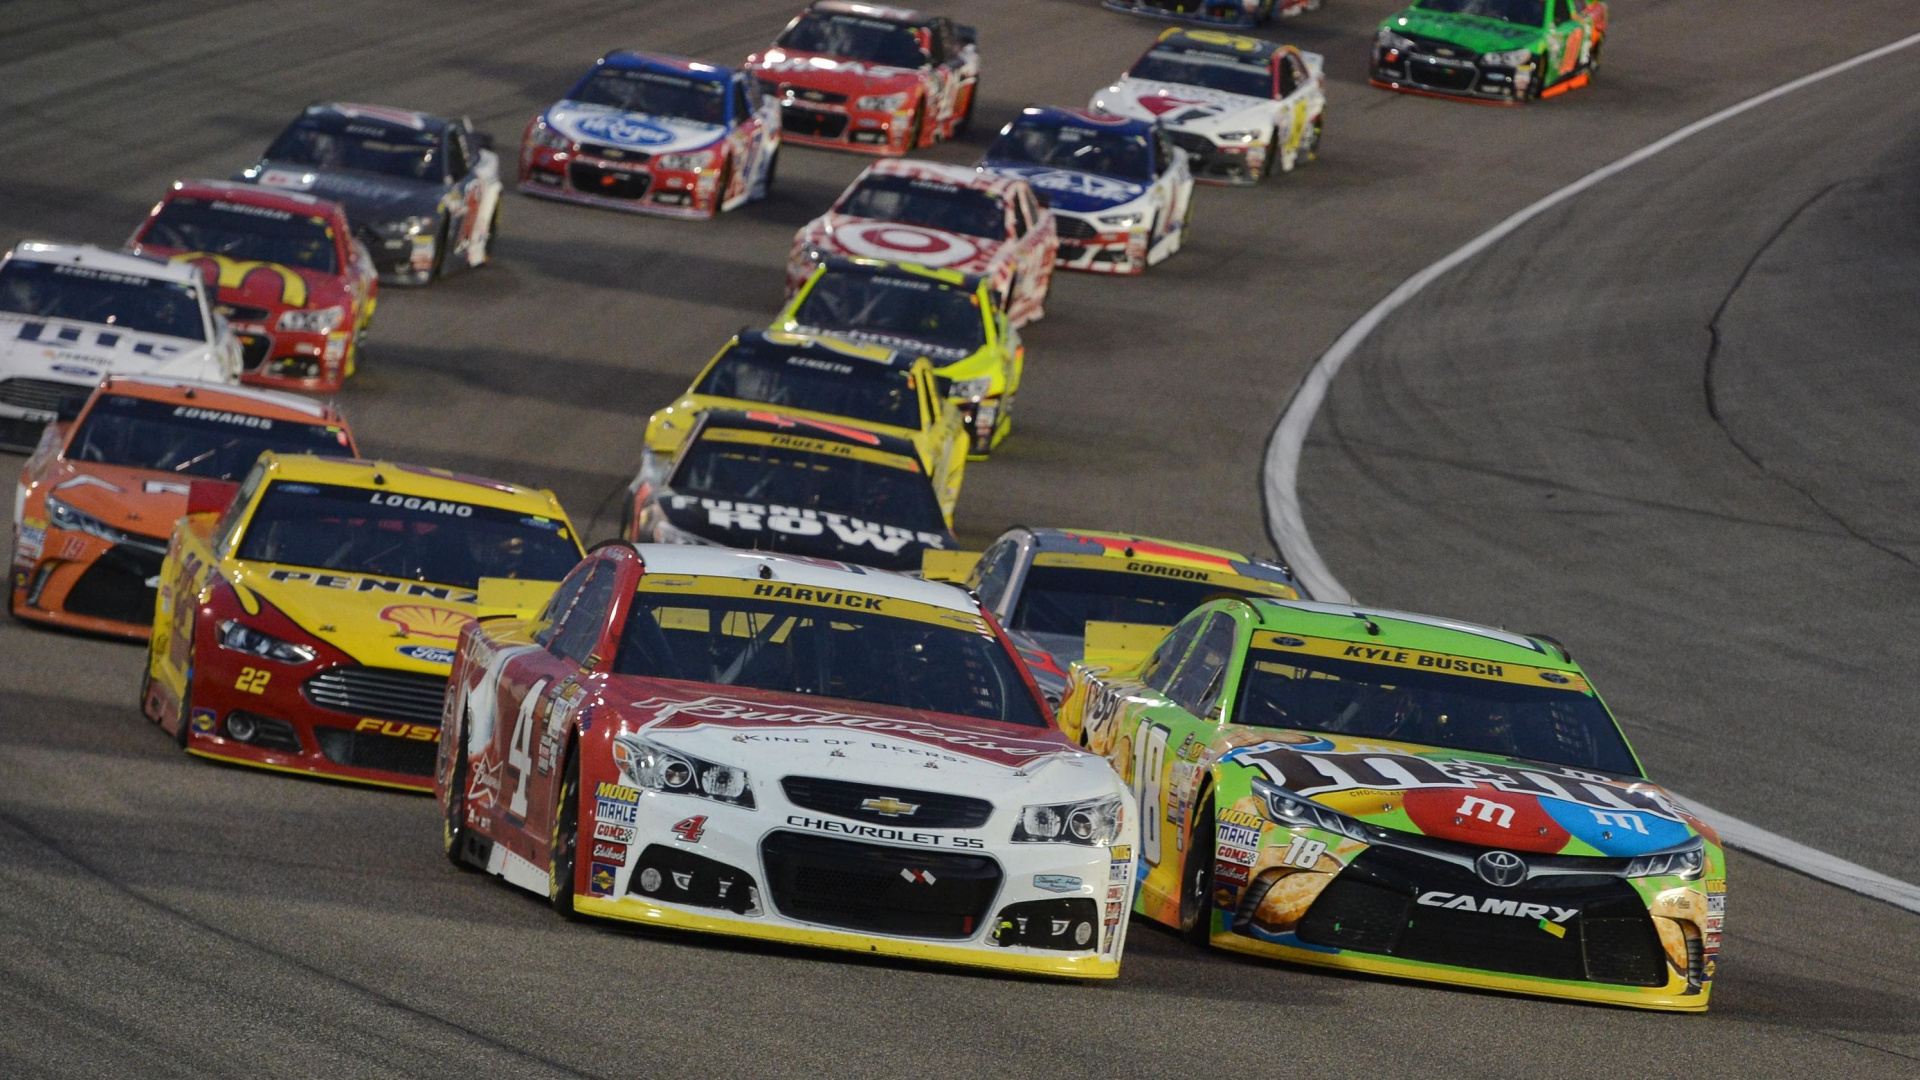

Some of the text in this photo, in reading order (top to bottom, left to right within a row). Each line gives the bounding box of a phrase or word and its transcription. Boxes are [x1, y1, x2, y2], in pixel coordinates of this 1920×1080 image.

[582, 117, 670, 142] Kroger
[787, 356, 853, 374] KENSETH
[173, 406, 272, 430] EDWARDS
[770, 434, 824, 450] TRUEX
[369, 492, 473, 517] LOGANO
[671, 495, 944, 550] FURNITURE
[708, 509, 910, 555] ROW
[1126, 561, 1209, 581] GORDON
[753, 584, 883, 611] HARVICK
[1344, 645, 1504, 677] KYLE BUSCH
[234, 666, 271, 695] 22
[508, 678, 548, 818] 4
[745, 735, 809, 744] KING
[596, 782, 641, 803] MOOG
[597, 801, 637, 823] MAHLE
[1218, 808, 1262, 829] MOOG
[1456, 795, 1516, 829] m
[1589, 809, 1650, 836] m
[597, 824, 625, 838] COMP
[671, 814, 709, 843] 4
[786, 815, 984, 849] CHEVROLET SS
[1217, 825, 1260, 848] MAHLE
[1217, 845, 1248, 859] COMP
[1283, 836, 1328, 869] 18
[1417, 891, 1579, 923] CAMRY
